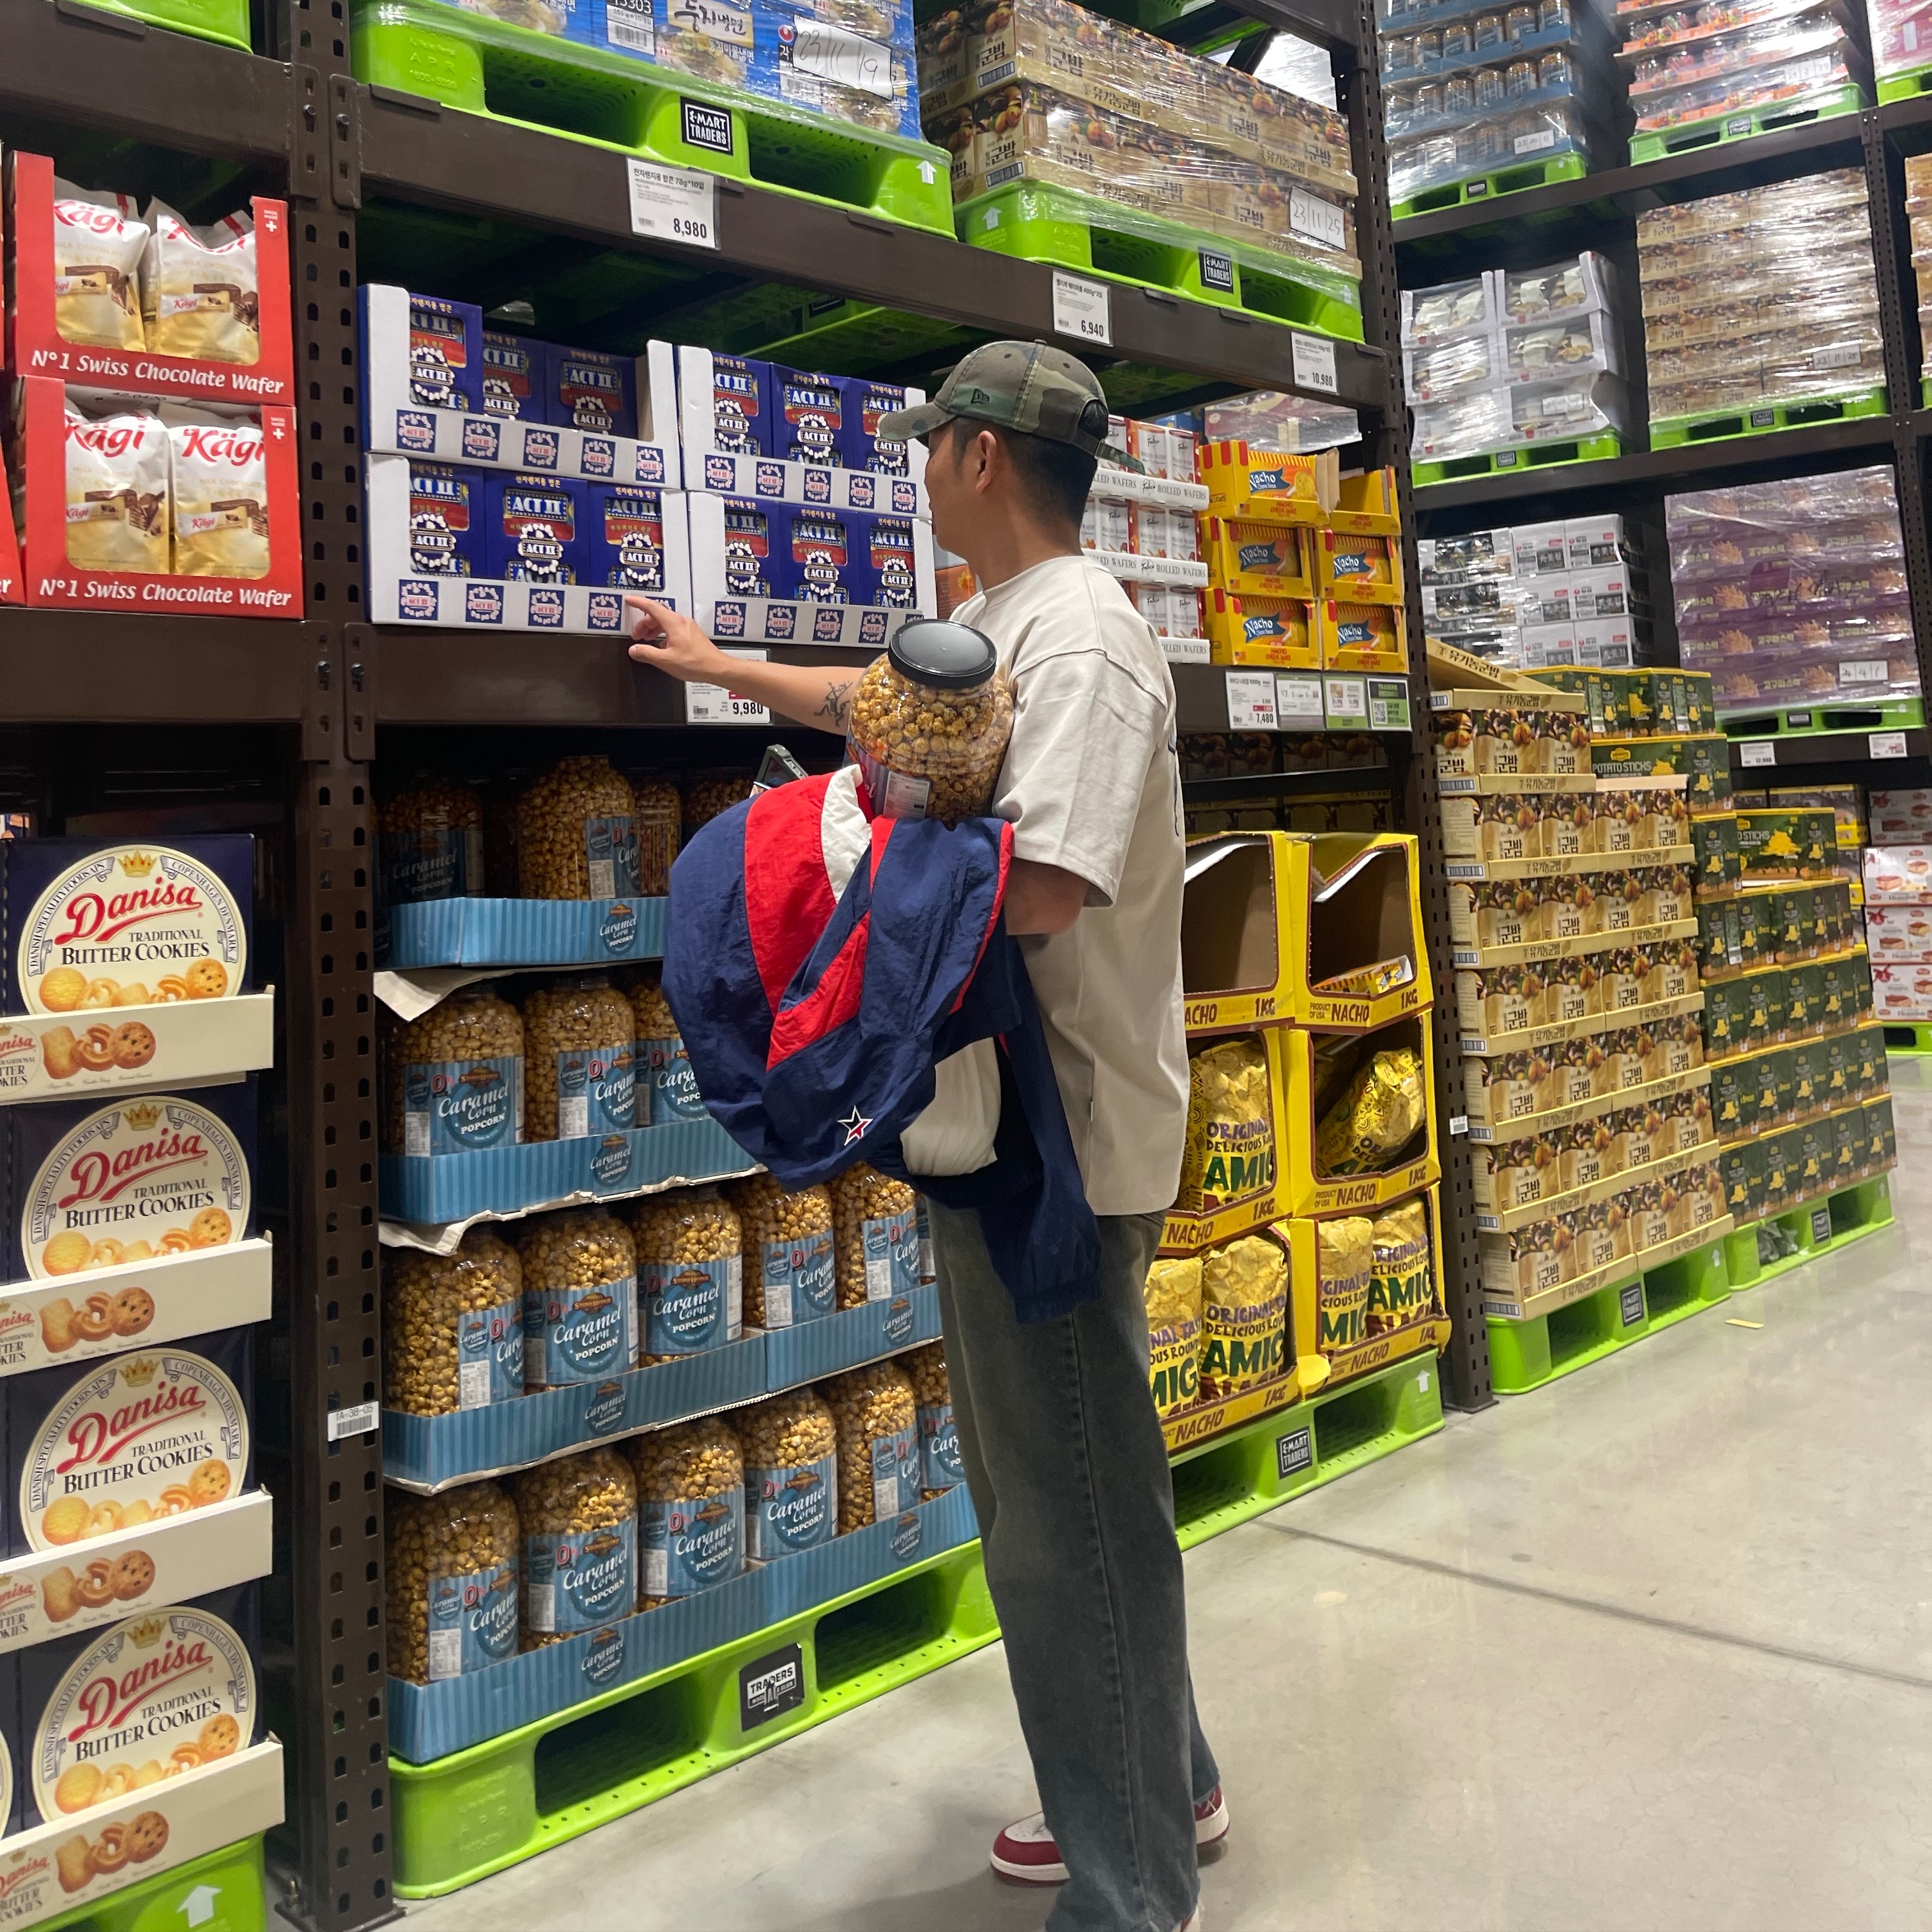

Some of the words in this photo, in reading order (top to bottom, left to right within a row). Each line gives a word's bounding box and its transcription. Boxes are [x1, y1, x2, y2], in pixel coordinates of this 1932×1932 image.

[981, 41, 1006, 66] 군밤
[690, 123, 727, 145] TRADERS
[991, 140, 1016, 165] 군밤
[1292, 202, 1307, 226] 23
[1312, 209, 1321, 228] 11
[673, 218, 707, 239] 8,980
[173, 299, 197, 310] Kägi
[1081, 319, 1104, 338] 6,940
[77, 355, 128, 377] Swiss
[135, 362, 225, 388] Chocolate
[232, 374, 284, 395] Wafer
[415, 366, 434, 379] ACT
[436, 369, 447, 381] II
[571, 368, 597, 388] ACT
[1312, 372, 1333, 387] 10,980
[792, 390, 815, 405] ACT
[817, 393, 831, 407] II
[1112, 477, 1137, 489] WAFERS
[1249, 473, 1276, 489] Nacho
[1157, 485, 1181, 496] ROLLED
[1184, 488, 1206, 500] WAFERS
[511, 497, 540, 514] ACT
[544, 500, 561, 516] II
[611, 498, 636, 514] ACT
[640, 501, 656, 517] II
[192, 516, 215, 529] Kägi
[415, 535, 433, 548] ACT
[435, 537, 448, 549] II
[799, 525, 822, 540] ACT
[824, 526, 838, 541] II
[874, 532, 896, 548] ACT
[898, 534, 910, 548] II
[526, 542, 544, 555] ACT
[545, 545, 557, 556] II
[627, 553, 643, 565] ACT
[644, 553, 654, 565] II
[1240, 547, 1268, 565] Nacho
[729, 561, 744, 571] ACT
[746, 562, 755, 572] II
[1112, 557, 1137, 569] WAFERS
[1156, 565, 1181, 576] ROLLED
[1183, 566, 1206, 578] WAFERS
[1333, 556, 1360, 575] Nacho
[84, 580, 136, 599] Swiss
[142, 583, 233, 604] Chocolate
[240, 588, 292, 607] Wafer
[1245, 619, 1273, 638] Nacho
[1337, 626, 1363, 645] Nacho
[1184, 644, 1208, 654] WAFERS
[1448, 648, 1499, 678] 유기농군밤
[733, 702, 763, 716] 9,980
[1506, 694, 1540, 708] 유기농군밤
[1256, 713, 1273, 724] 7,480
[1439, 758, 1465, 774] 군밤
[1498, 755, 1518, 774] 군밤
[1558, 755, 1575, 774] 군밤
[1593, 762, 1622, 773] POTATO
[1623, 761, 1652, 772] STICKS
[1743, 831, 1770, 841] STICKS
[1503, 838, 1522, 859] 군밤
[54, 876, 203, 946] Danisa
[128, 930, 203, 942] TRADITIONAL
[600, 915, 638, 937] Caramel
[61, 945, 132, 965] BUTTER
[134, 942, 210, 961] COOKIES
[1310, 1002, 1331, 1012] PRODUCT
[1331, 1004, 1370, 1023] NACHO
[1508, 1008, 1527, 1029] 군밤
[438, 1077, 510, 1117] Caramel
[468, 1103, 496, 1120] Corn
[460, 1113, 505, 1135] POPCORN
[1206, 1138, 1262, 1153] DELICIOUS
[59, 1128, 208, 1209] Danisa
[134, 1178, 208, 1199] TRADITIONAL
[1336, 1183, 1376, 1206] NACHO
[65, 1204, 135, 1229] BUTTER
[139, 1192, 215, 1218] COOKIES
[1167, 1221, 1215, 1245] NACHO
[1541, 1263, 1560, 1287] 군밤
[652, 1279, 721, 1317] Caramel
[678, 1304, 707, 1321] Corn
[554, 1301, 622, 1345] Caramel
[672, 1313, 716, 1334] POPCORN
[1206, 1319, 1266, 1338] DELICIOUS
[582, 1328, 610, 1347] Corn
[575, 1336, 618, 1362] POPCORN
[1351, 1342, 1390, 1372] NACHO
[56, 1381, 206, 1475] Danisa
[1175, 1409, 1225, 1445] NACHO
[131, 1430, 206, 1459] TRADITIONAL
[1284, 1446, 1308, 1466] TRADERS
[63, 1463, 134, 1495] BUTTER
[137, 1442, 213, 1476] COOKIES
[767, 1483, 828, 1524] Caramel
[786, 1511, 825, 1537] POPCORN
[675, 1516, 738, 1558] Caramel
[563, 1546, 629, 1591] Caramel
[694, 1545, 735, 1572] POPCORN
[584, 1577, 626, 1607] POPCORN
[581, 1640, 624, 1671] Caramel
[68, 1639, 213, 1742] Danisa
[141, 1685, 215, 1720] TRADITIONAL
[75, 1723, 146, 1764] BUTTER
[147, 1697, 222, 1737] COOKIES
